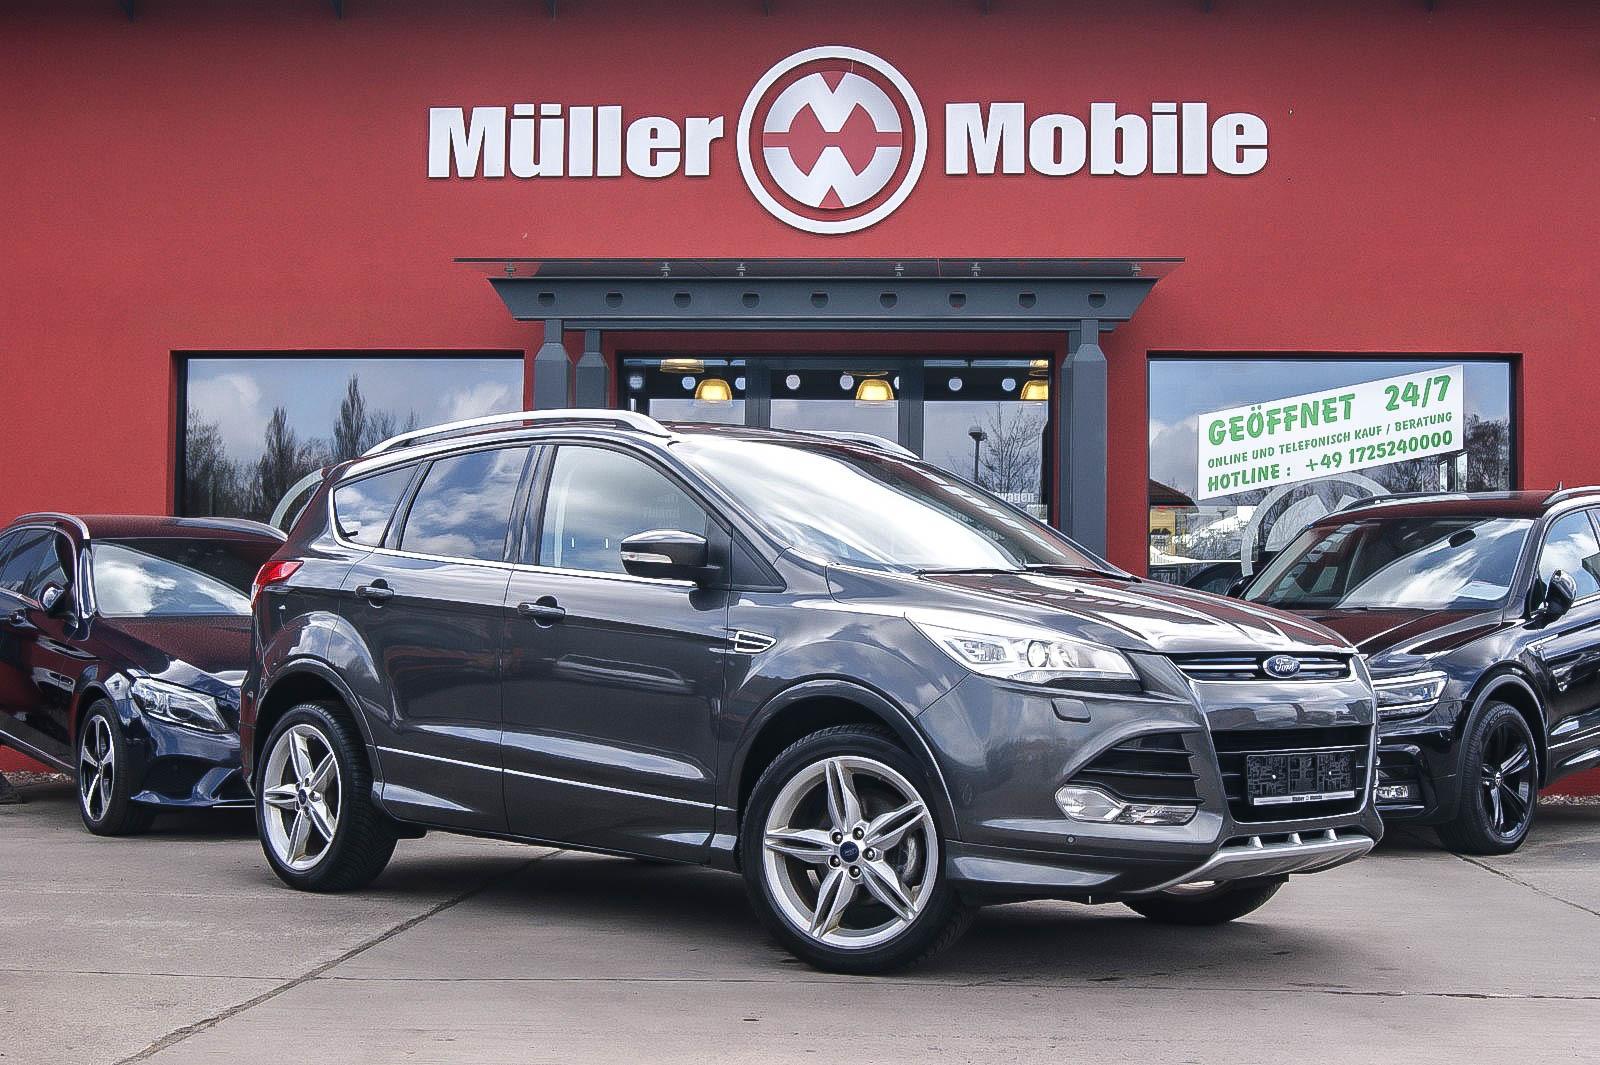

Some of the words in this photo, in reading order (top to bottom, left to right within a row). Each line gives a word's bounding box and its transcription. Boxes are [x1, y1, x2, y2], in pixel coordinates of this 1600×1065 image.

[428, 104, 723, 177] Müller
[945, 102, 1267, 175] Mobile
[1207, 393, 1356, 446] GEÖFFNET
[1384, 374, 1452, 412] 24/7
[1207, 452, 1249, 469] ONLINE
[1251, 447, 1275, 460] UND
[1278, 430, 1351, 455] TELEFONISCH
[1354, 424, 1383, 440] KAUF
[1394, 411, 1453, 432] BERATUNG
[1207, 463, 1281, 493] HOTLINE
[1305, 451, 1343, 472] +49
[1348, 430, 1453, 463] 1725240000
[1275, 658, 1296, 672] Ford
